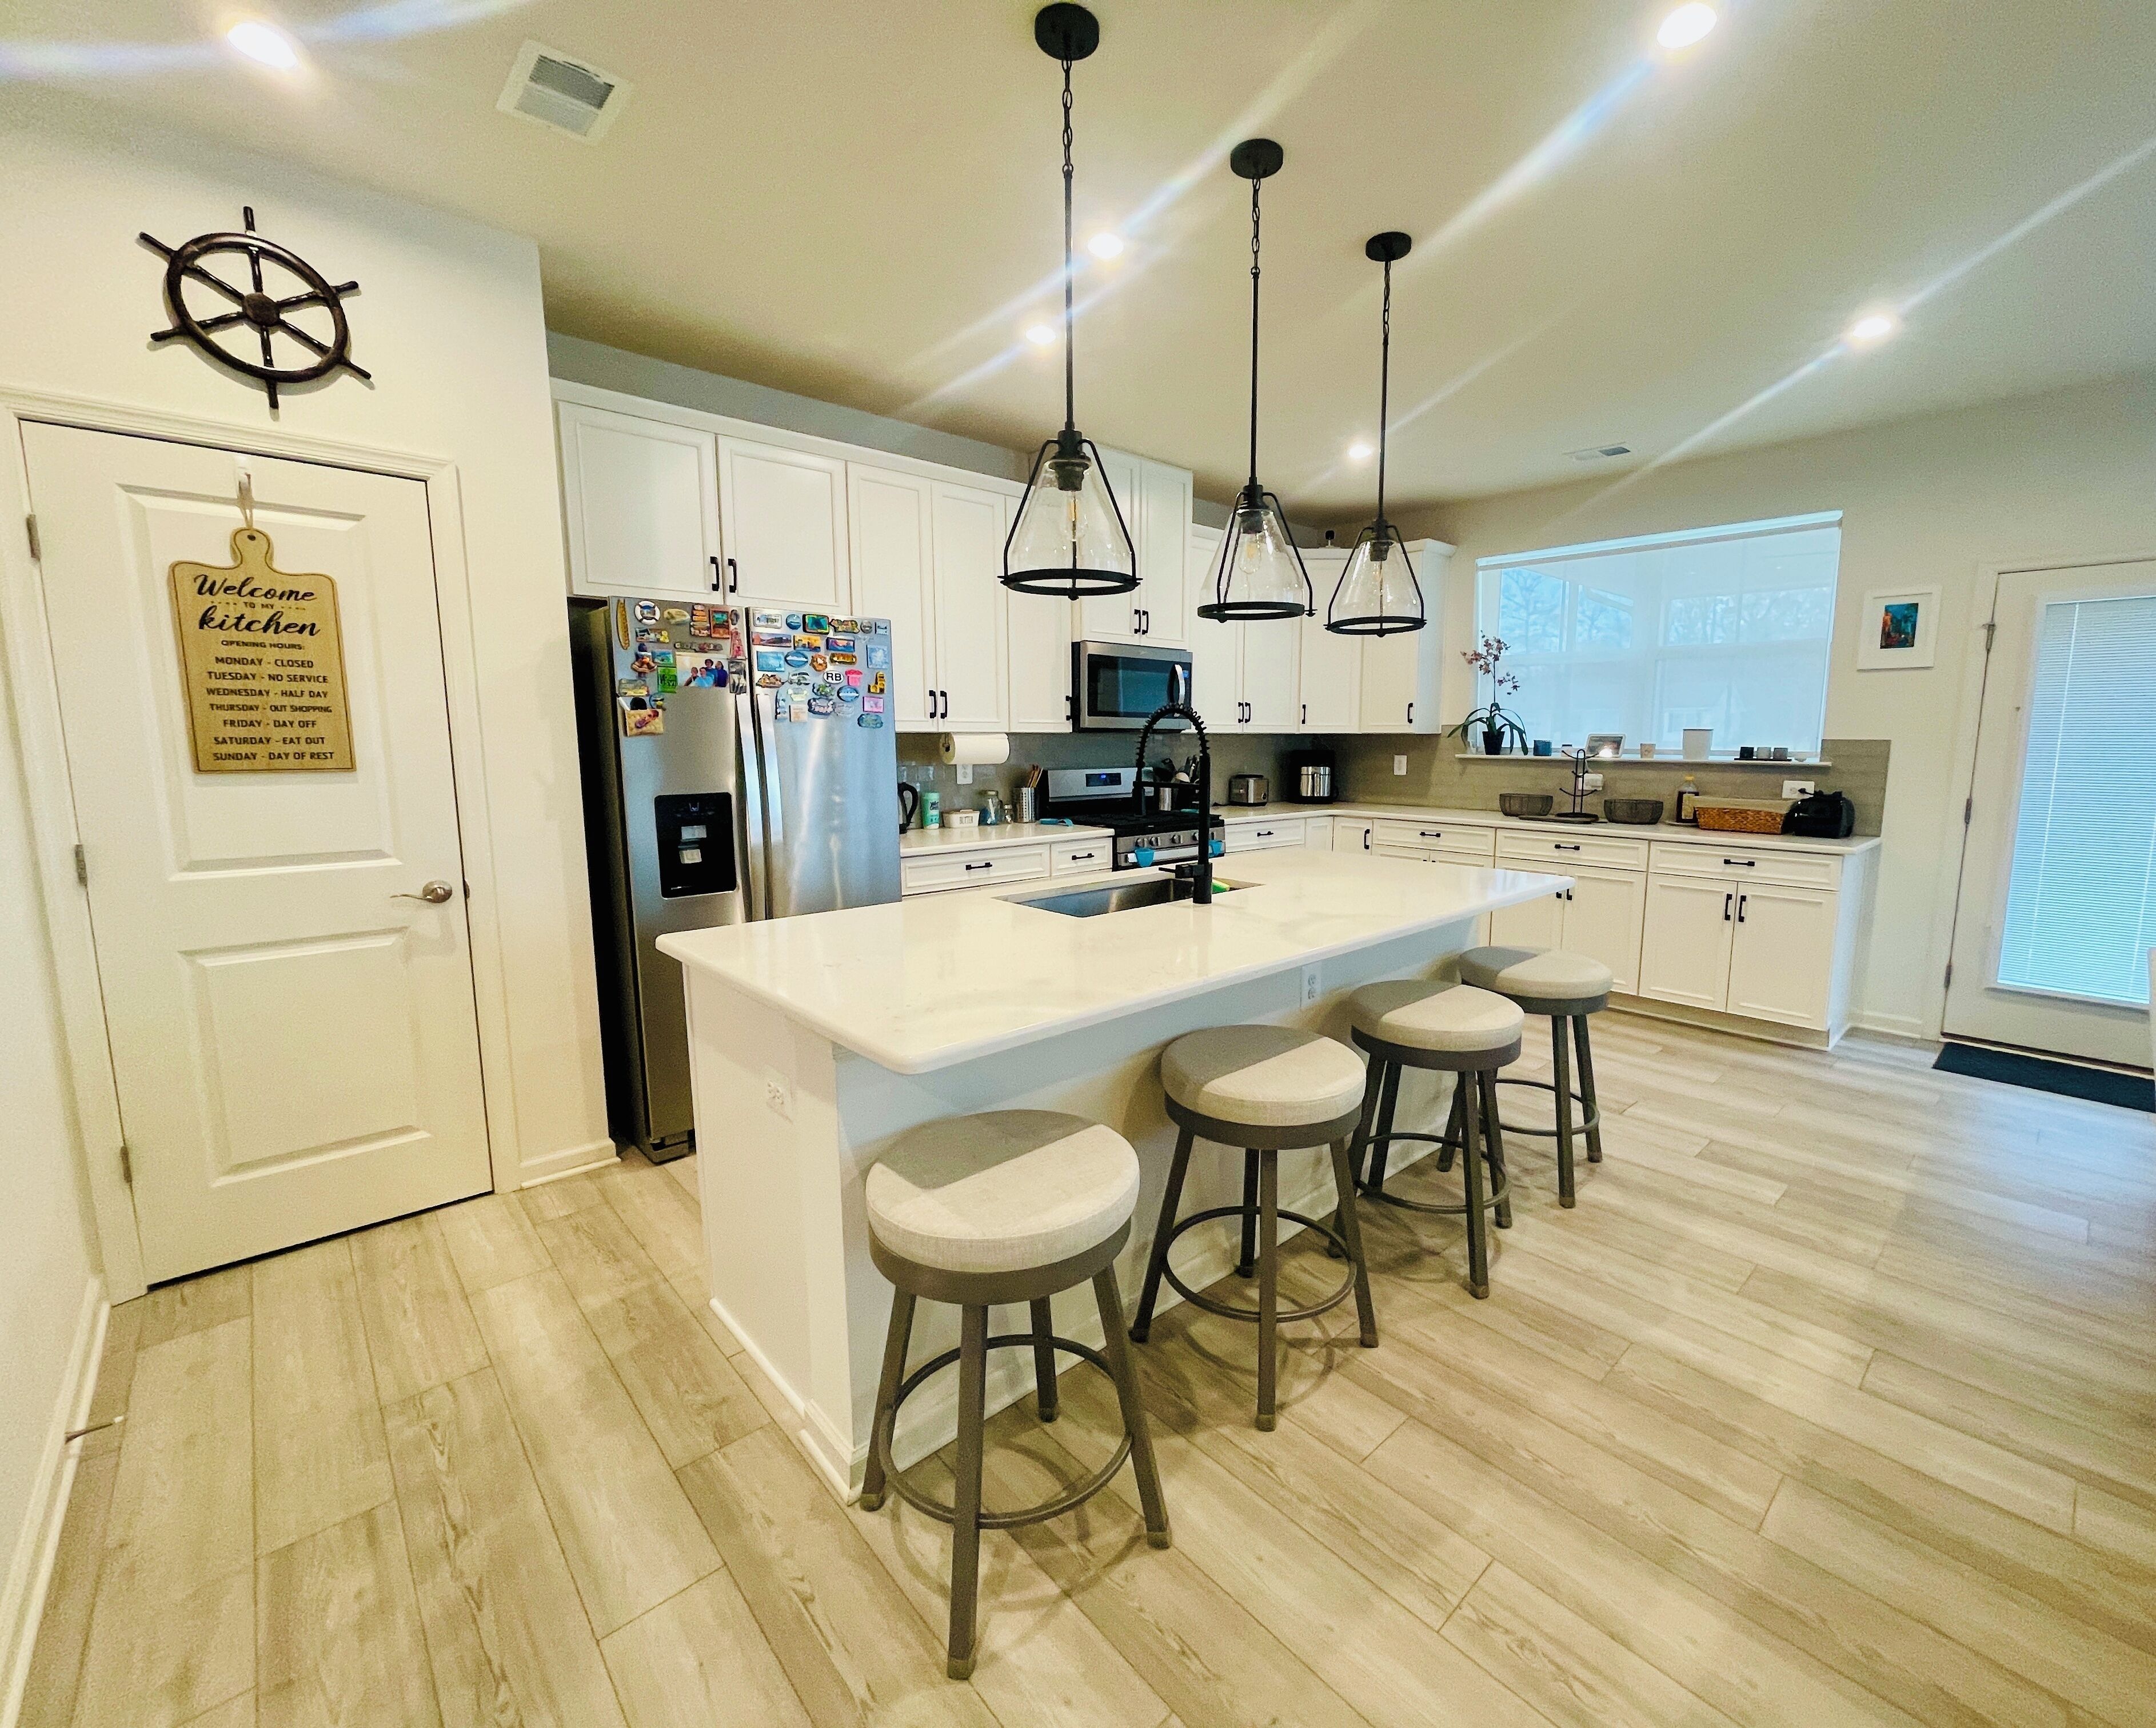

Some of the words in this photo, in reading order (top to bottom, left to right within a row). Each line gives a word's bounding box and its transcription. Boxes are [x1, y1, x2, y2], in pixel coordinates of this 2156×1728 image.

[194, 574, 317, 601] Welcome
[198, 605, 321, 636] kitchen
[221, 640, 266, 649] OPENING
[215, 657, 263, 666] MONDAY
[274, 659, 314, 668] CLOSED
[207, 671, 257, 681] TUESDAY
[268, 674, 283, 682] NO
[287, 674, 328, 683] SERVICE
[255, 671, 270, 681] RB
[206, 687, 270, 697] WEDNESDAY
[281, 690, 305, 698] HALF
[309, 690, 328, 698] DAY
[209, 703, 259, 712] THURSDAY
[270, 705, 287, 713] OUT
[290, 705, 333, 713] SHOPPING
[223, 719, 262, 727] FRIDAY
[273, 720, 294, 728] DAY
[298, 720, 317, 728] OFF
[214, 737, 272, 745] SATURDAY
[282, 737, 302, 745] EAT
[305, 737, 325, 745] OUT
[213, 752, 258, 761] SUNDAY
[268, 752, 290, 760] DAY
[293, 752, 306, 760] OF
[310, 751, 334, 759] REST
